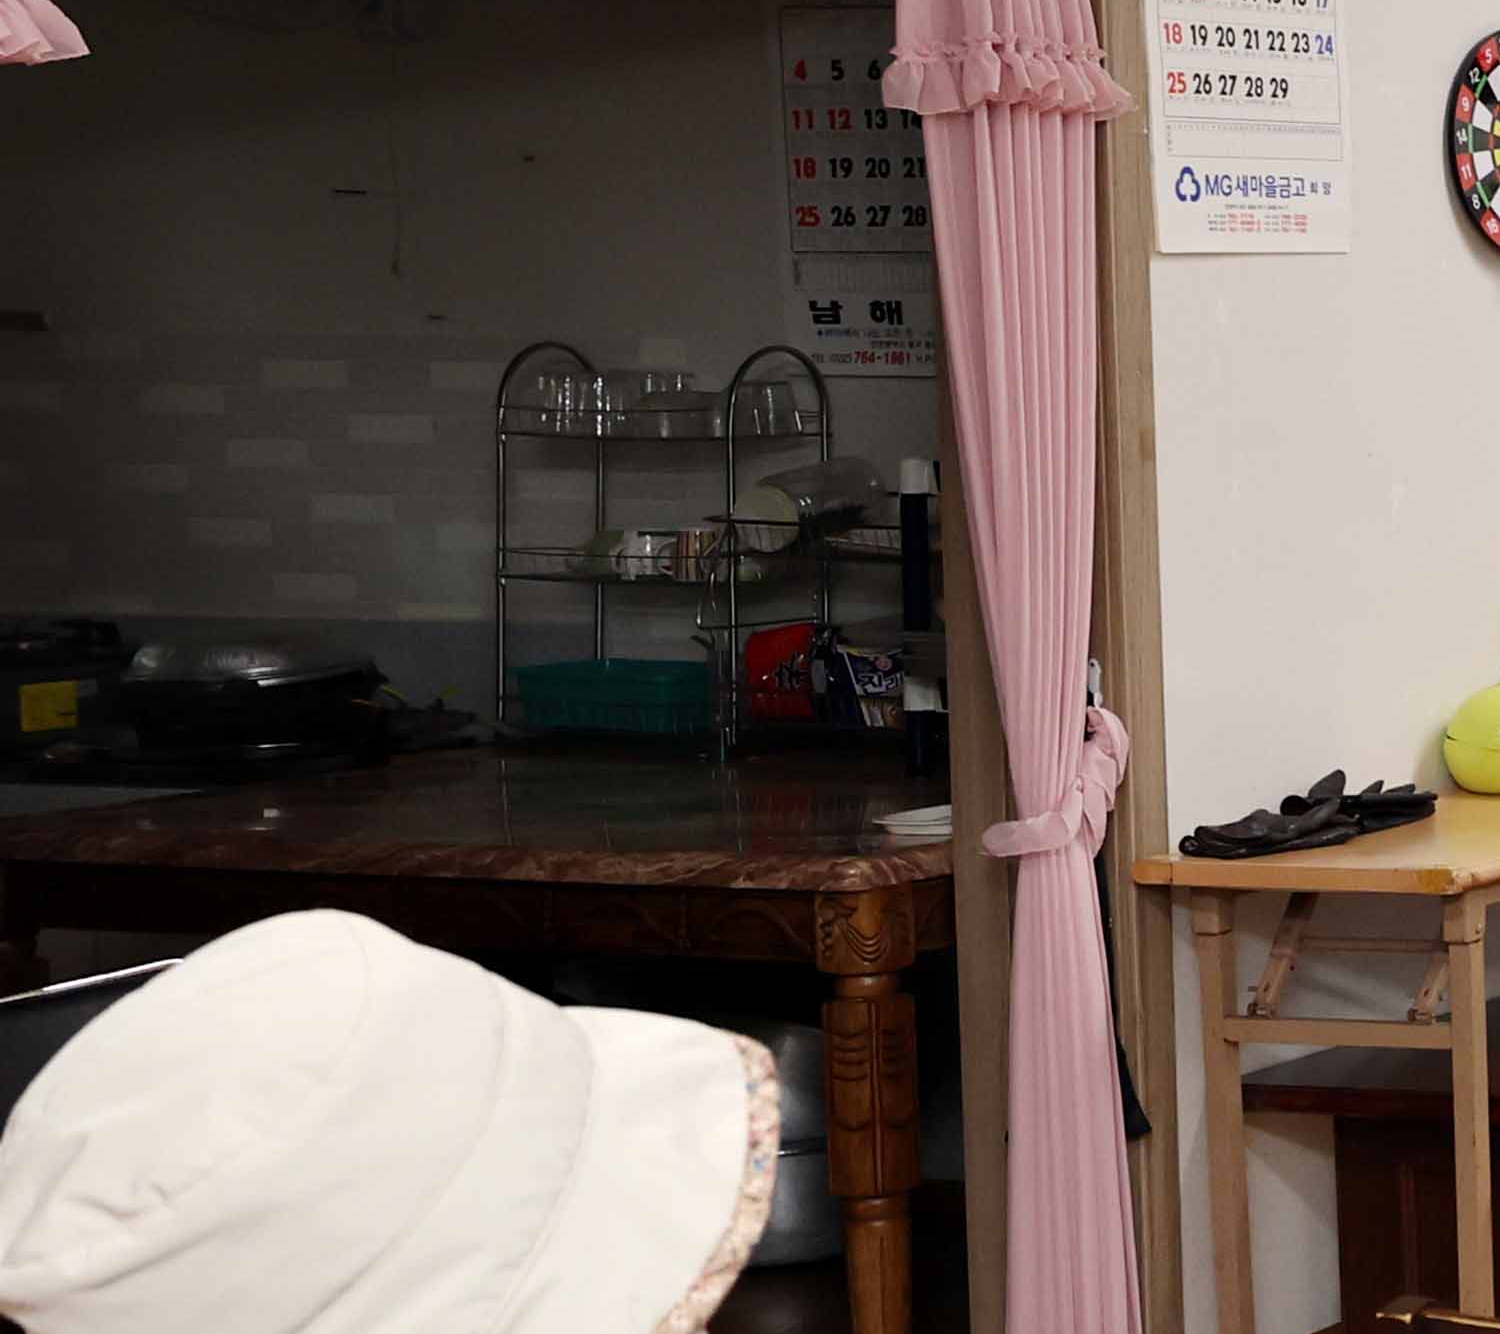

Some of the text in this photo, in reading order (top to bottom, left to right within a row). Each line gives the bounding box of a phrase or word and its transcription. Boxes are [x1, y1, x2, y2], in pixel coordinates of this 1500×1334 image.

[1163, 23, 1333, 55] 18 19 20 21 22 23 24
[1484, 49, 1492, 63] 5
[794, 59, 881, 80] 4 5 6
[1469, 70, 1480, 84] 12
[1167, 72, 1289, 99] 25 26 27 28 29
[1462, 98, 1470, 111] 9
[792, 110, 815, 130] 11
[827, 110, 851, 130] 12
[864, 109, 888, 130] 13
[1457, 129, 1468, 144] 14
[793, 158, 926, 179] 18 19 20 21
[1462, 164, 1472, 178] 11
[1472, 195, 1480, 209] 8
[795, 206, 927, 227] 25 26 27 28
